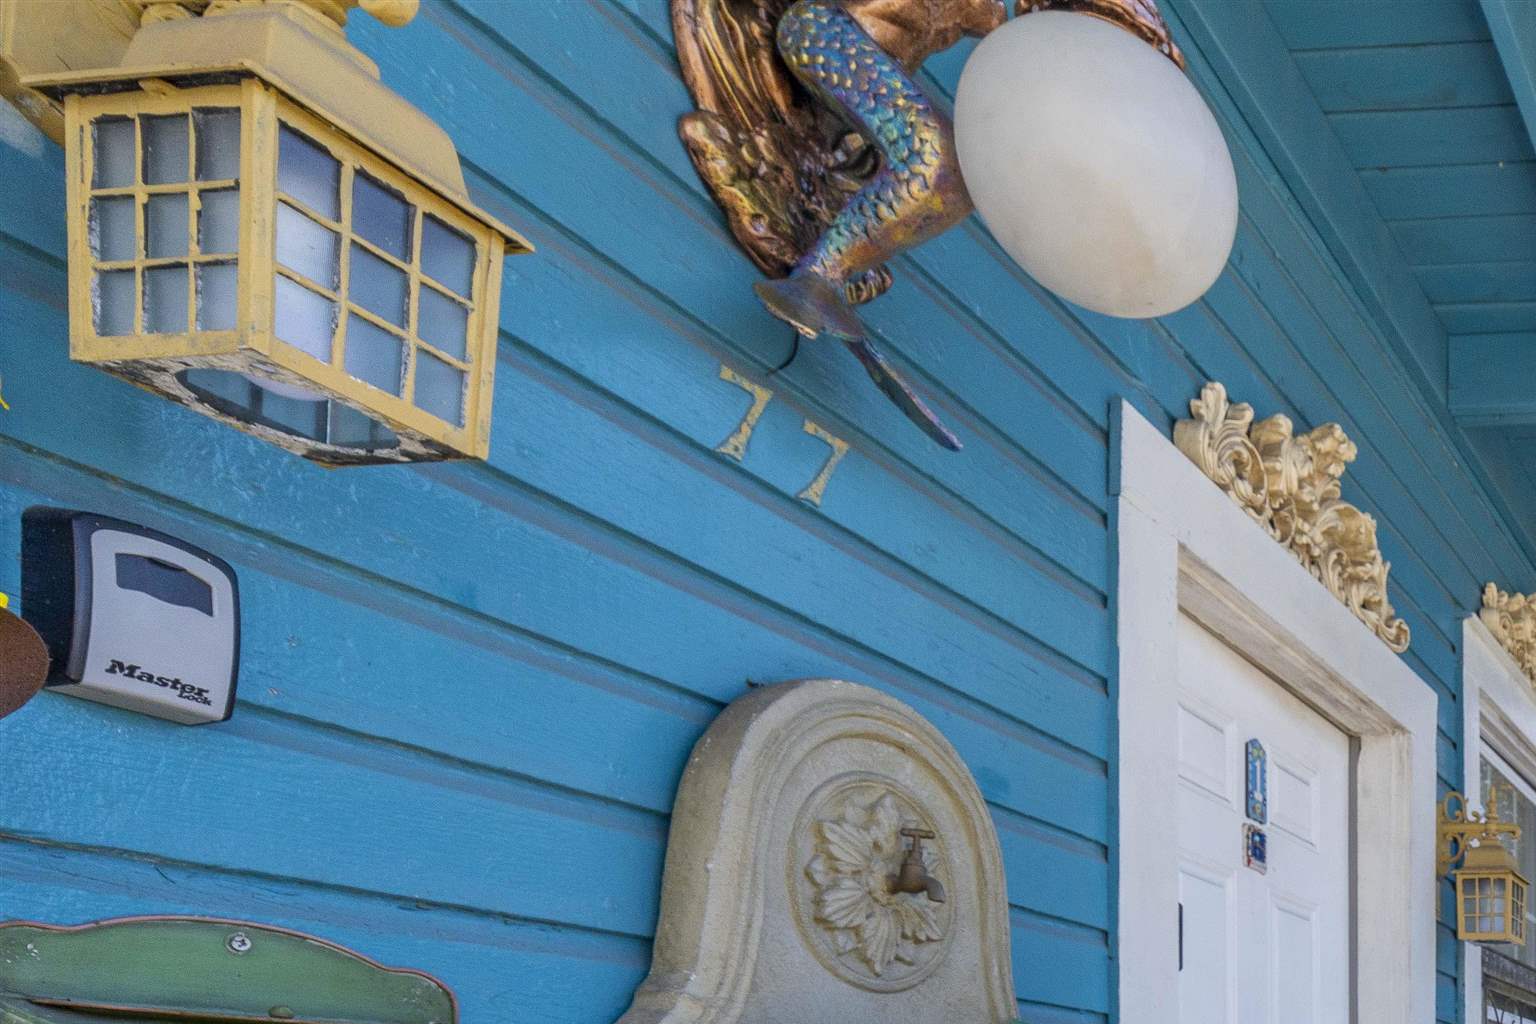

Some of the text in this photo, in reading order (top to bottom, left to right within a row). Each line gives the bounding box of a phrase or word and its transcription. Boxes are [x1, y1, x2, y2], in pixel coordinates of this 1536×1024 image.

[714, 365, 849, 508] 77
[105, 659, 209, 697] Master
[178, 692, 212, 706] Lock
